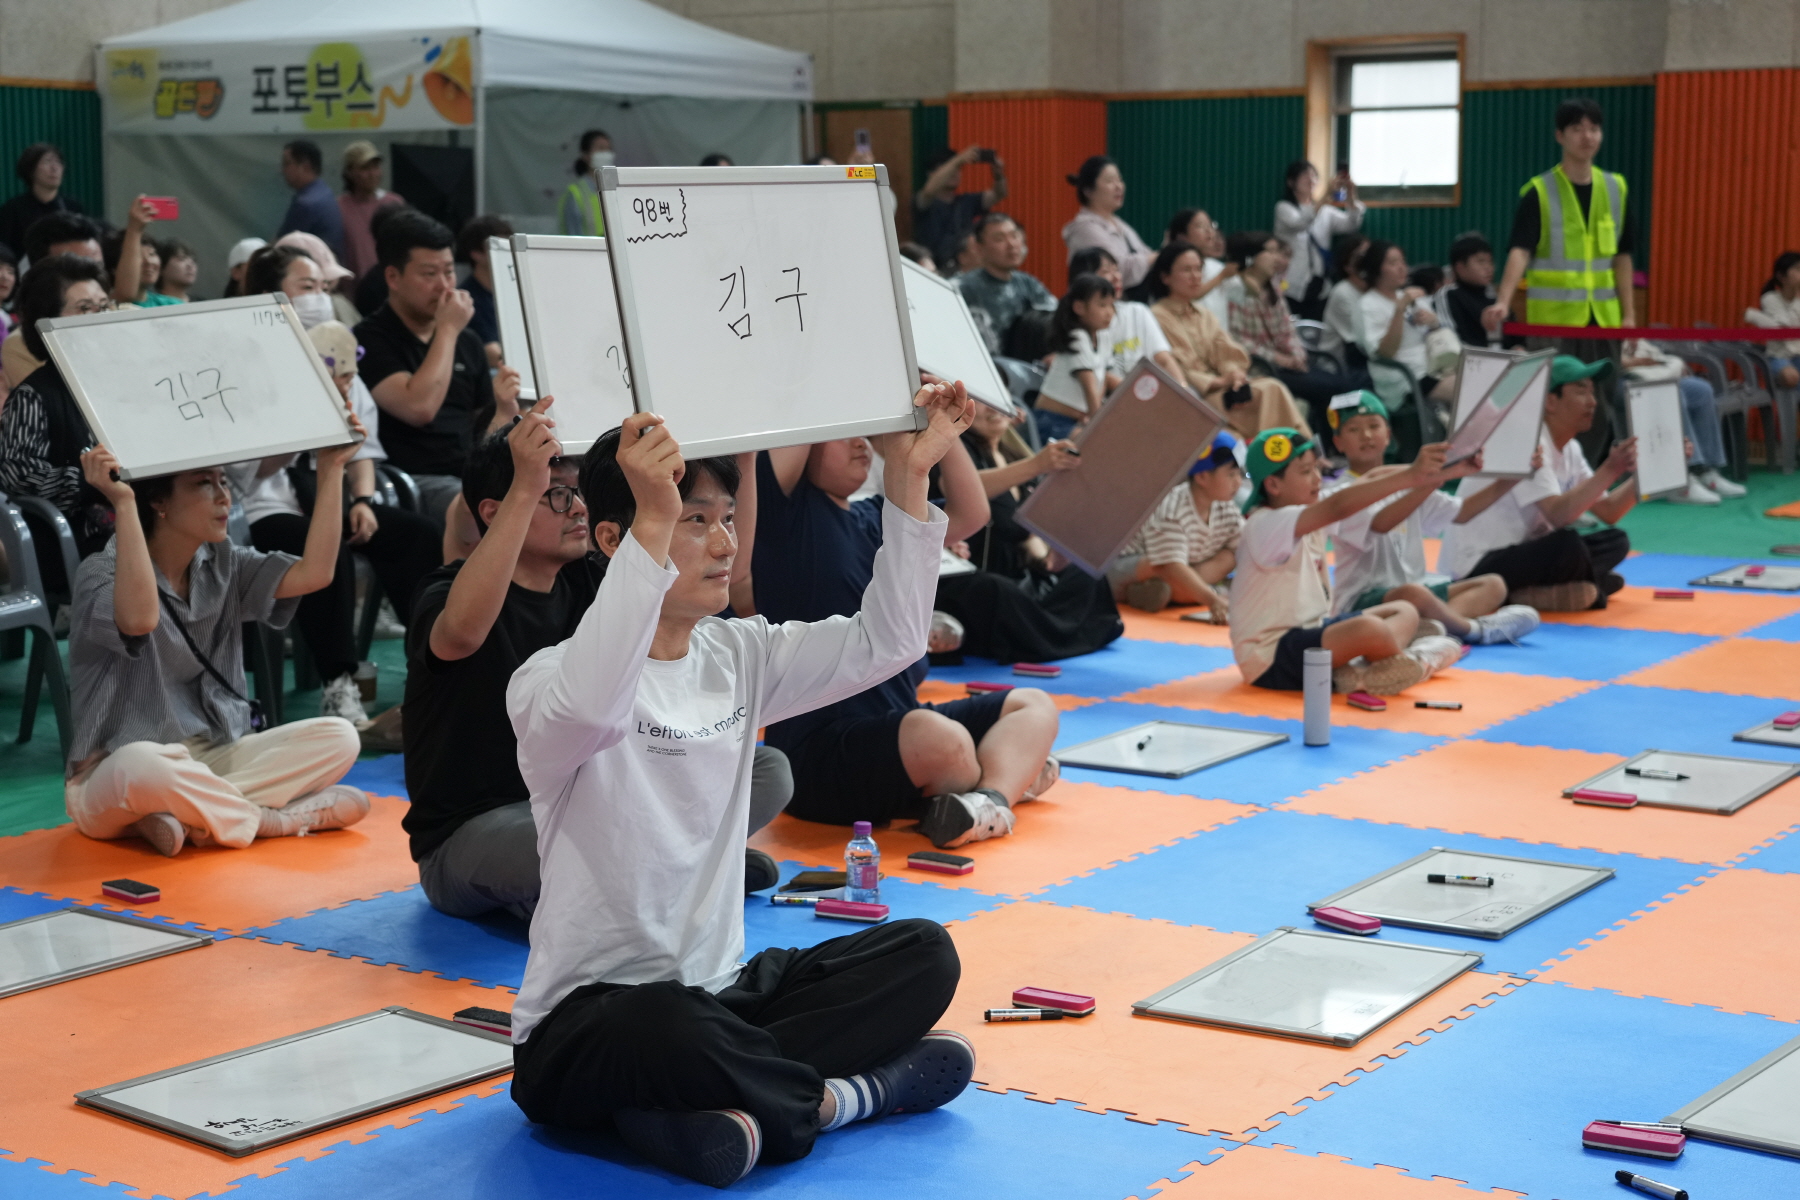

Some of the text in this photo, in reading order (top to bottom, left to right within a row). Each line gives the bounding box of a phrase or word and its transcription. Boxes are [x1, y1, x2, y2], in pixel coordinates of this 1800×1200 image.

[251, 62, 376, 118] 포토부스
[632, 197, 673, 227] 98번
[154, 367, 239, 424] 김구
